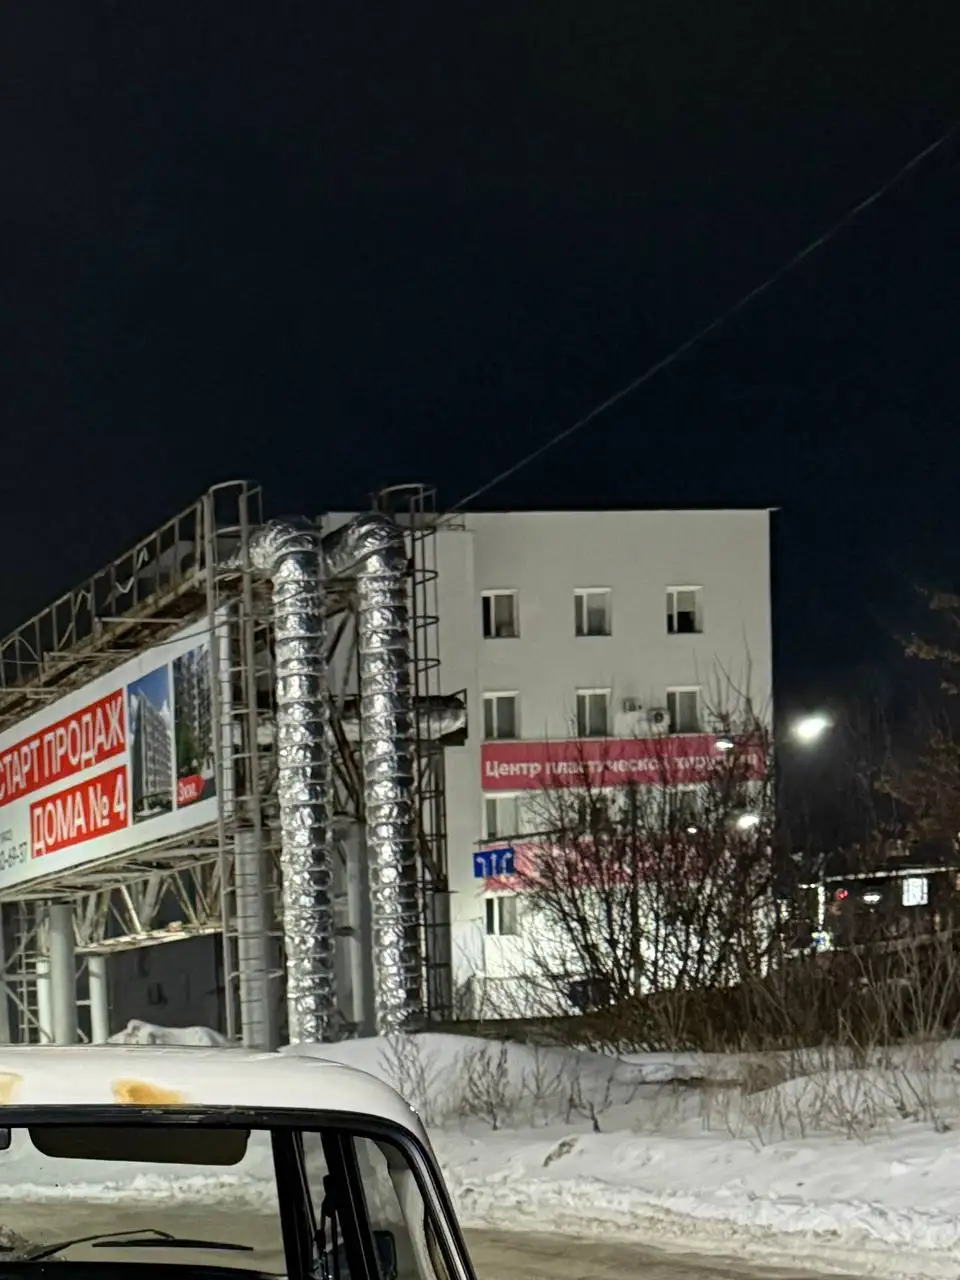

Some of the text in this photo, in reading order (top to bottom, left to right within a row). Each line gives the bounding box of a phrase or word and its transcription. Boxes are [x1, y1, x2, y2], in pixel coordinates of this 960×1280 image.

[42, 695, 125, 778] ПРОДАЖ
[485, 760, 542, 778] Центр
[32, 789, 86, 856] ДОМА
[88, 781, 110, 829] №
[113, 773, 126, 821] 4
